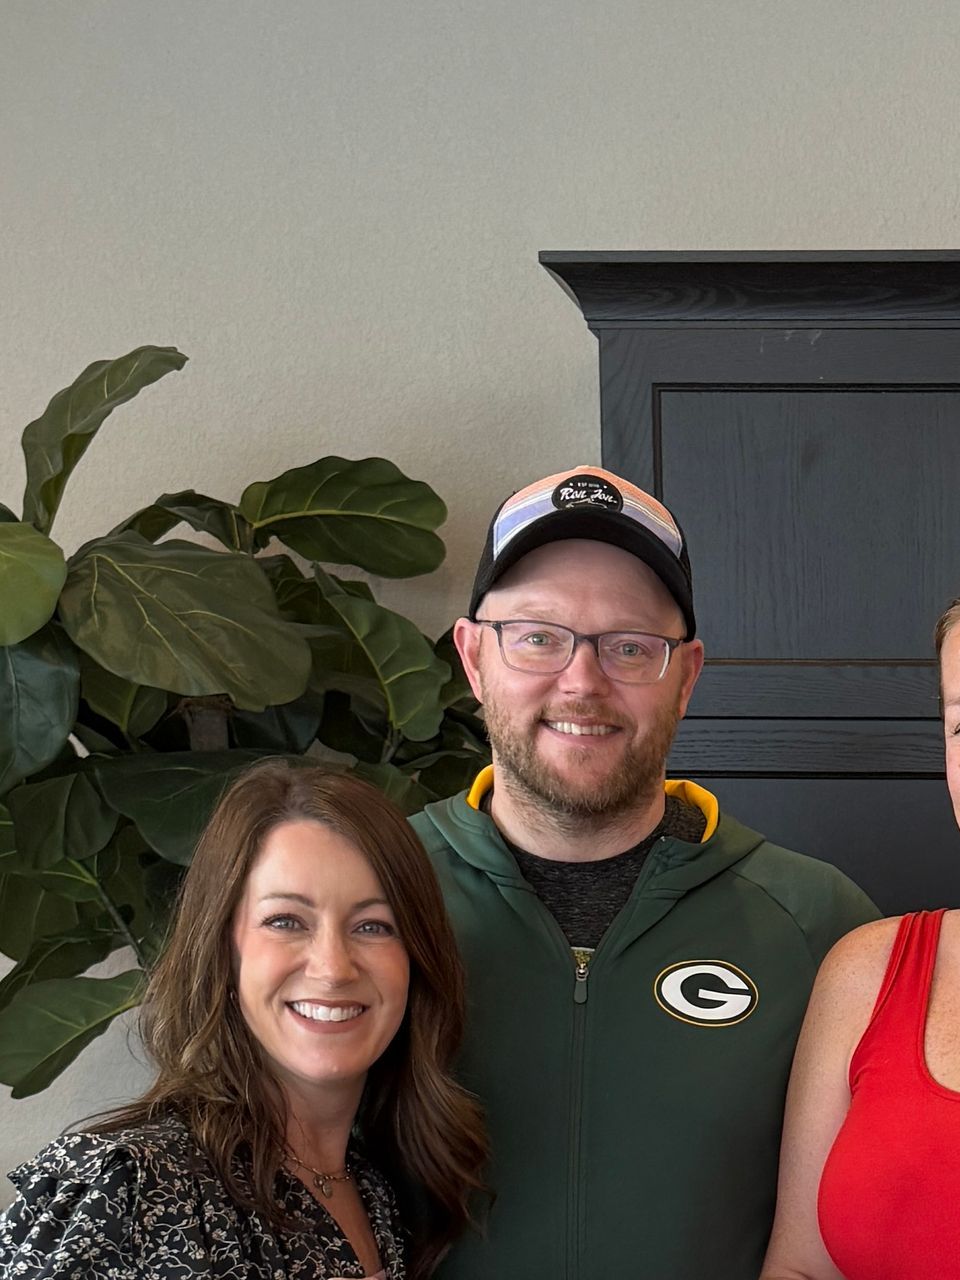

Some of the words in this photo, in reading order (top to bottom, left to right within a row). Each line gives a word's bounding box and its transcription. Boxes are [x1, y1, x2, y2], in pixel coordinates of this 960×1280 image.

[559, 487, 587, 500] Ron
[590, 488, 617, 503] Jon
[661, 965, 752, 1020] G
